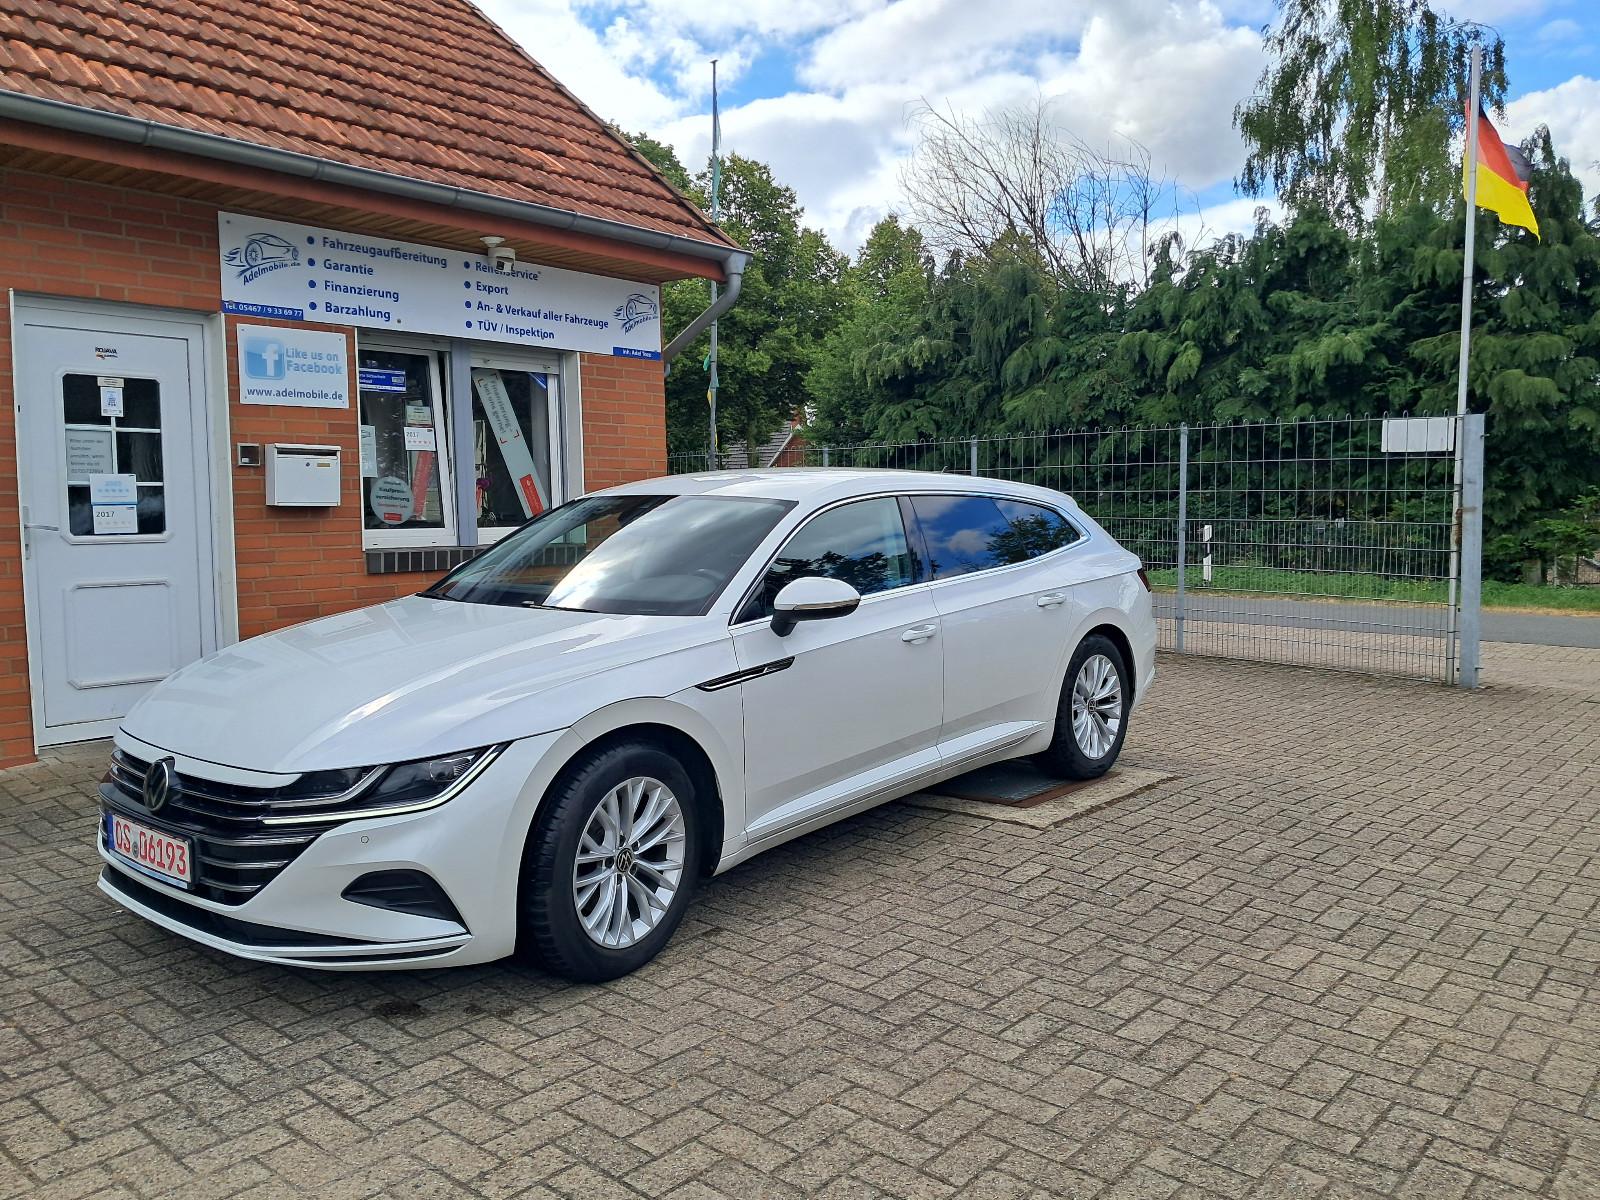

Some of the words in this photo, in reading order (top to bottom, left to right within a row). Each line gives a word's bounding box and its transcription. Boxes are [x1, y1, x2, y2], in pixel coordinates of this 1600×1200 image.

[322, 236, 447, 268] Fahrzeugaufbereitung
[323, 258, 374, 276] Garantie
[324, 280, 400, 302] Finanzierung
[476, 281, 509, 295] Export
[238, 304, 262, 313] 05467
[325, 301, 391, 322] Barzahlung
[476, 301, 494, 312] An-
[496, 303, 504, 314] &
[505, 305, 542, 319] Verkauf
[543, 310, 563, 322] aller
[564, 314, 609, 330] Fahrzeuge
[477, 319, 498, 333] TÜV
[505, 324, 555, 340] Inspektion
[285, 348, 308, 360] Like
[311, 351, 324, 361] us
[326, 352, 339, 362] on
[285, 360, 343, 375] Facebook
[247, 387, 343, 401] www.adelmobile.de
[115, 820, 131, 853] OS
